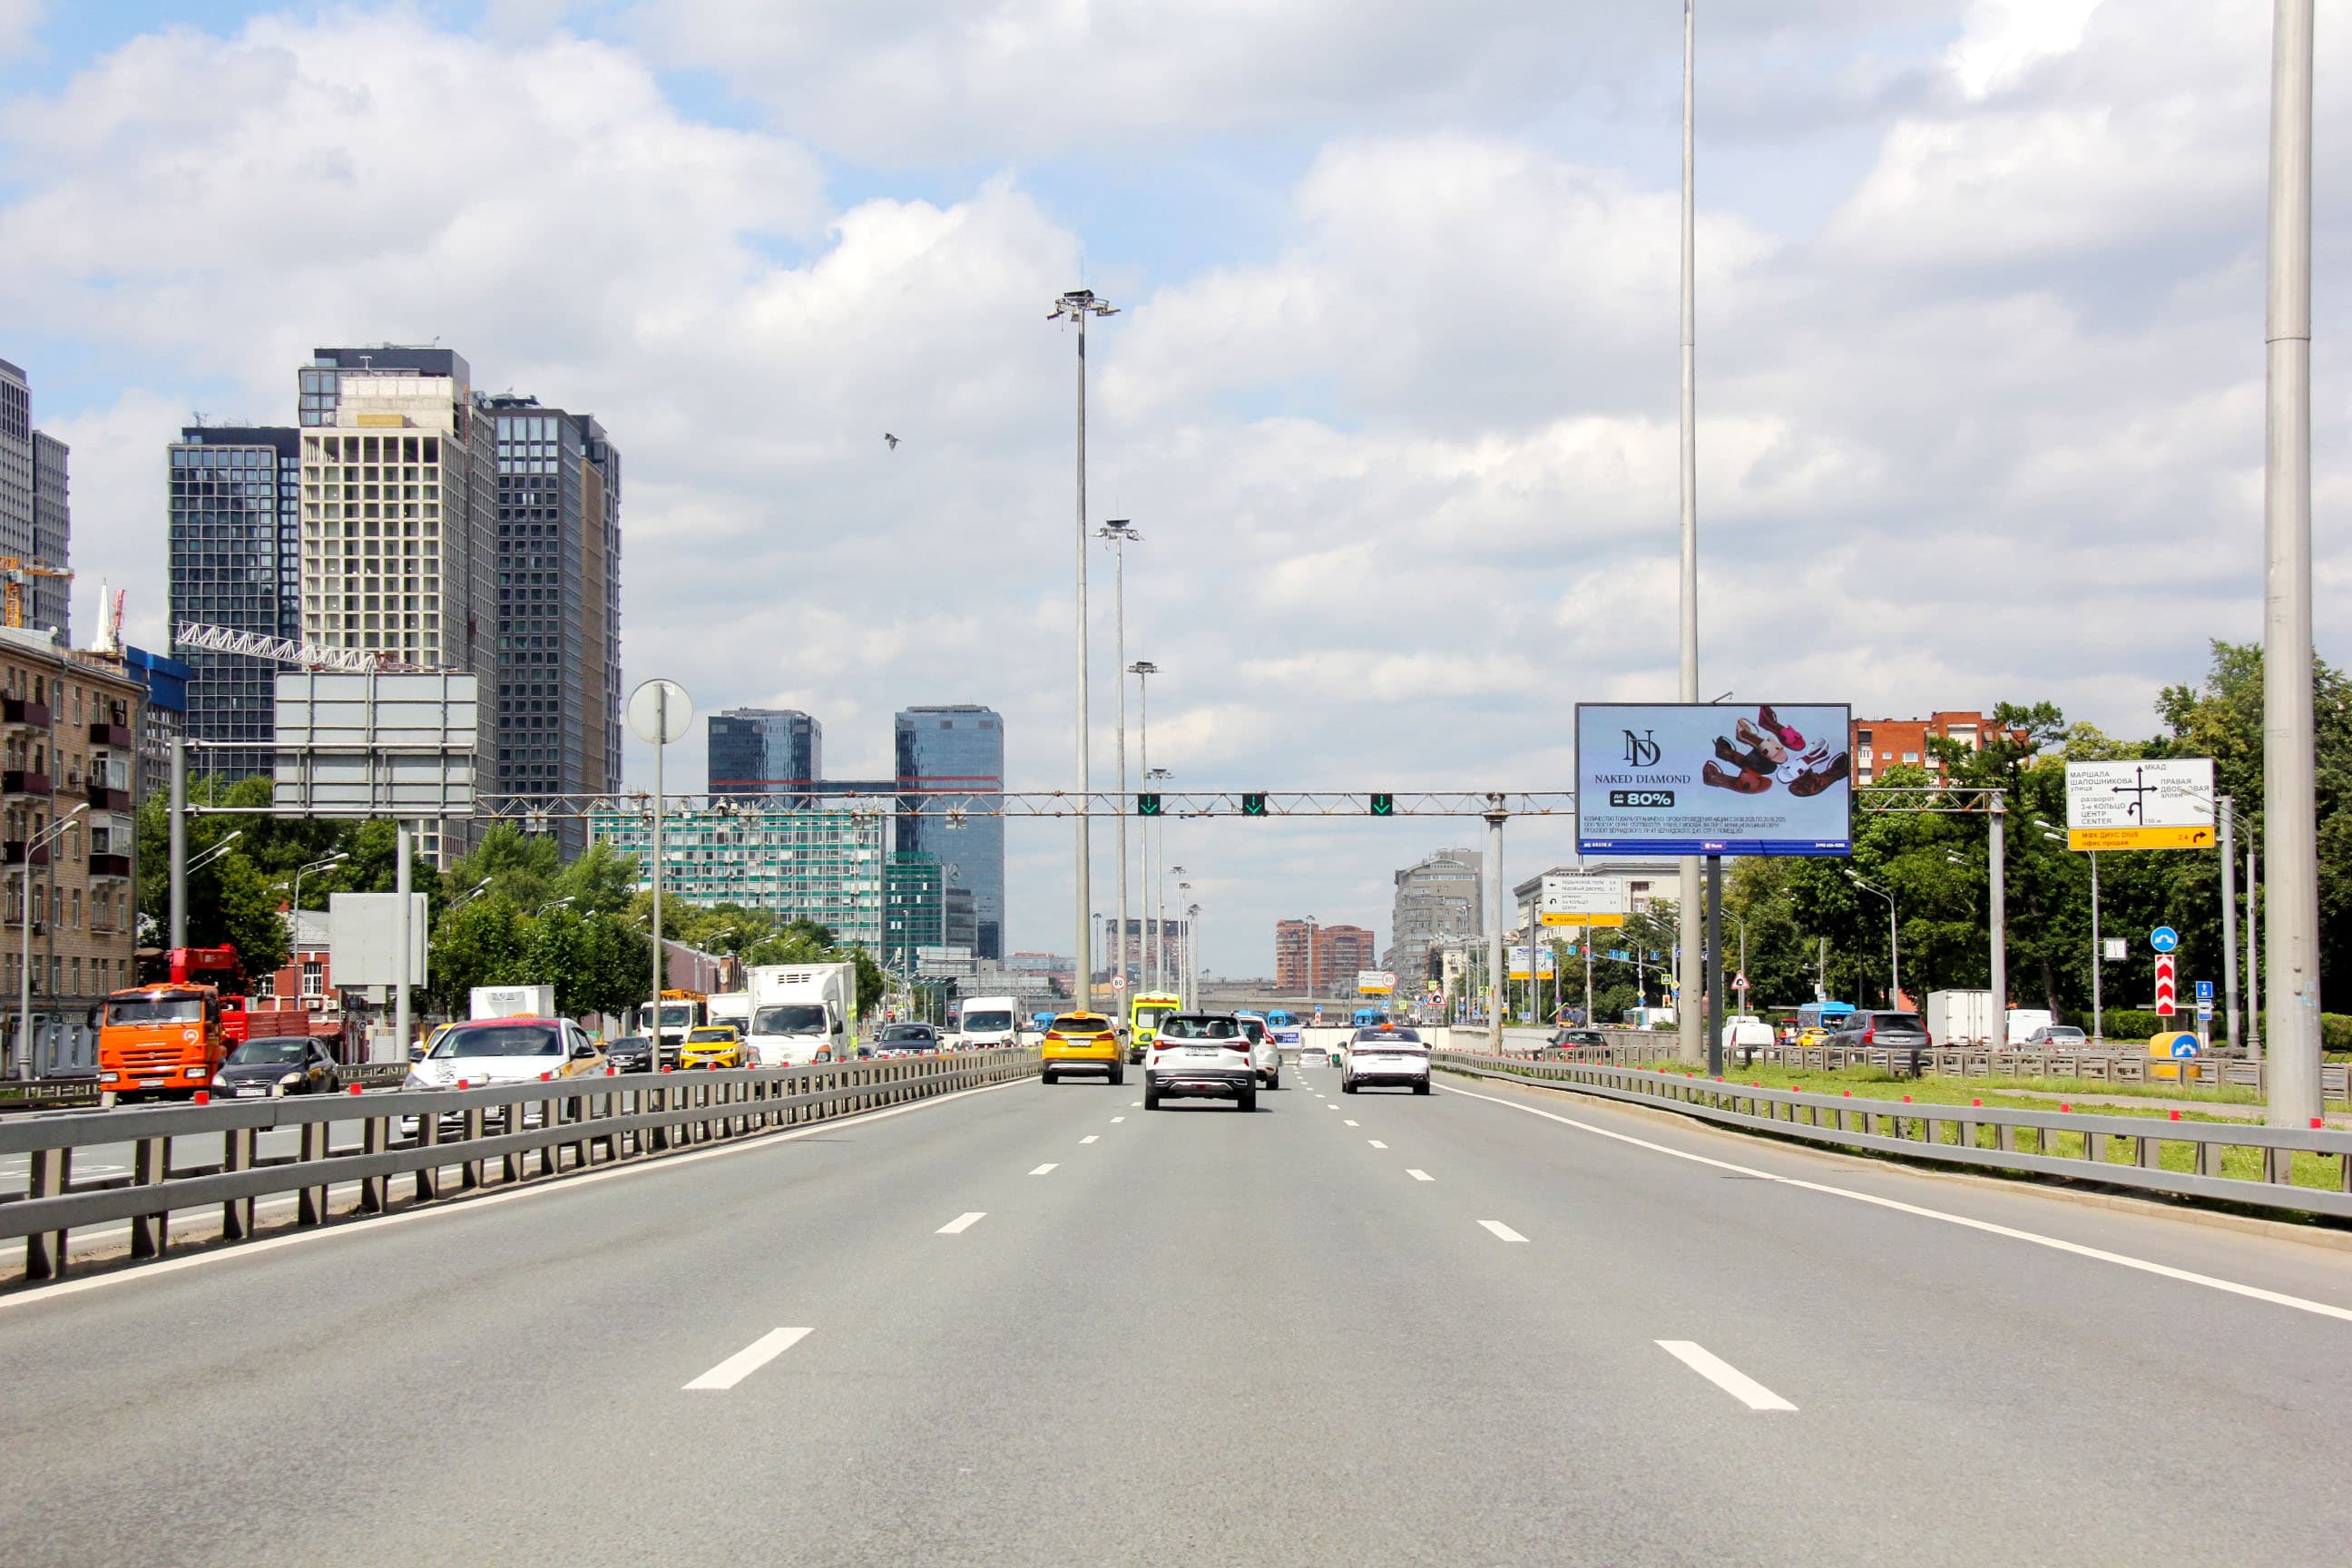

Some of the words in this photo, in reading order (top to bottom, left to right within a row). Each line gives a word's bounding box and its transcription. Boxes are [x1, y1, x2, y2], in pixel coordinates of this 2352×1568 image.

[1622, 730, 1661, 768] ND
[2144, 763, 2166, 771] МКАД
[2070, 770, 2111, 779] МАРШАЛА
[1594, 774, 1633, 784] NAKED
[1636, 774, 1690, 784] DIAMOND
[2070, 778, 2132, 786] ШАПОШНИКОВА
[2161, 778, 2192, 786] ПРАВАЯ
[2093, 802, 2126, 810] КОЛЬЦО
[2081, 810, 2107, 818] ЦЕНТР
[1385, 975, 1395, 984] 80
